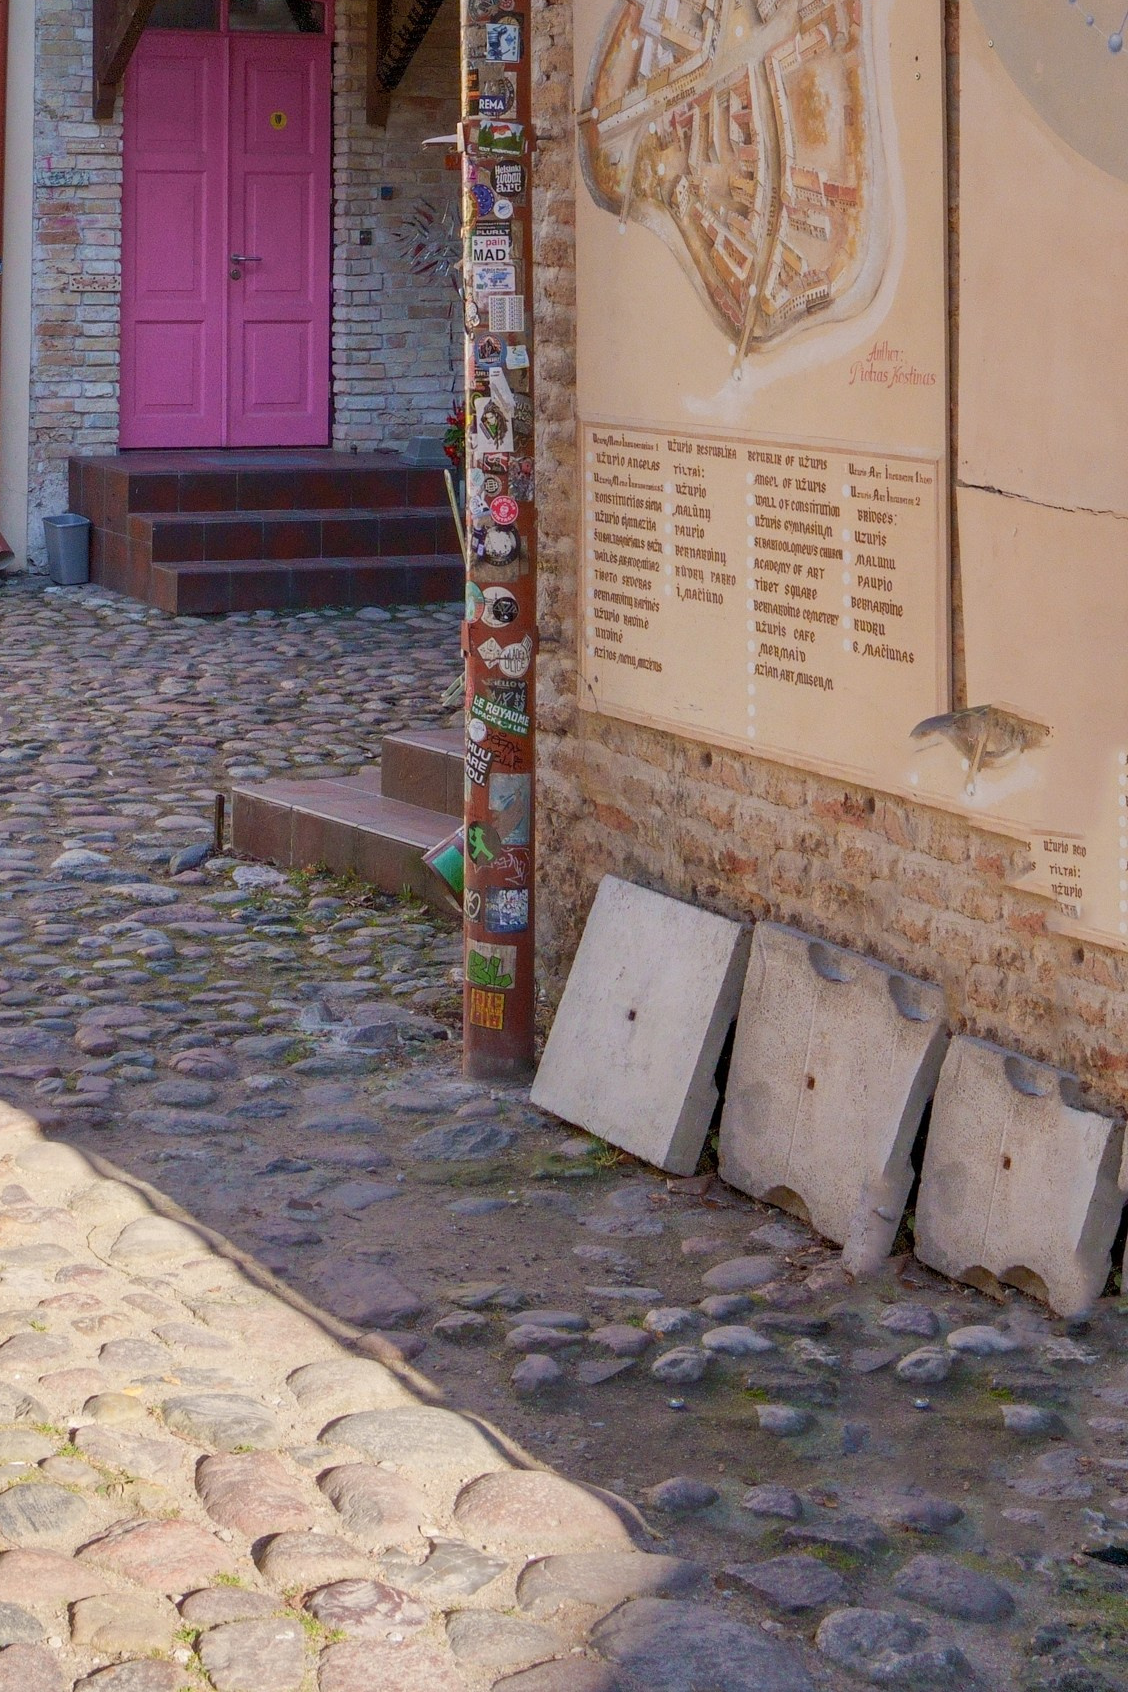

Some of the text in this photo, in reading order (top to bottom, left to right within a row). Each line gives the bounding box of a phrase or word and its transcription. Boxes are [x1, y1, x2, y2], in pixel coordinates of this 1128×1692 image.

[485, 238, 506, 247] pain
[473, 249, 506, 261] MAD
[785, 455, 794, 467] OF
[783, 478, 793, 489] OF
[474, 695, 485, 709] LE
[485, 702, 531, 727] ROYAUME
[466, 753, 488, 774] ARE
